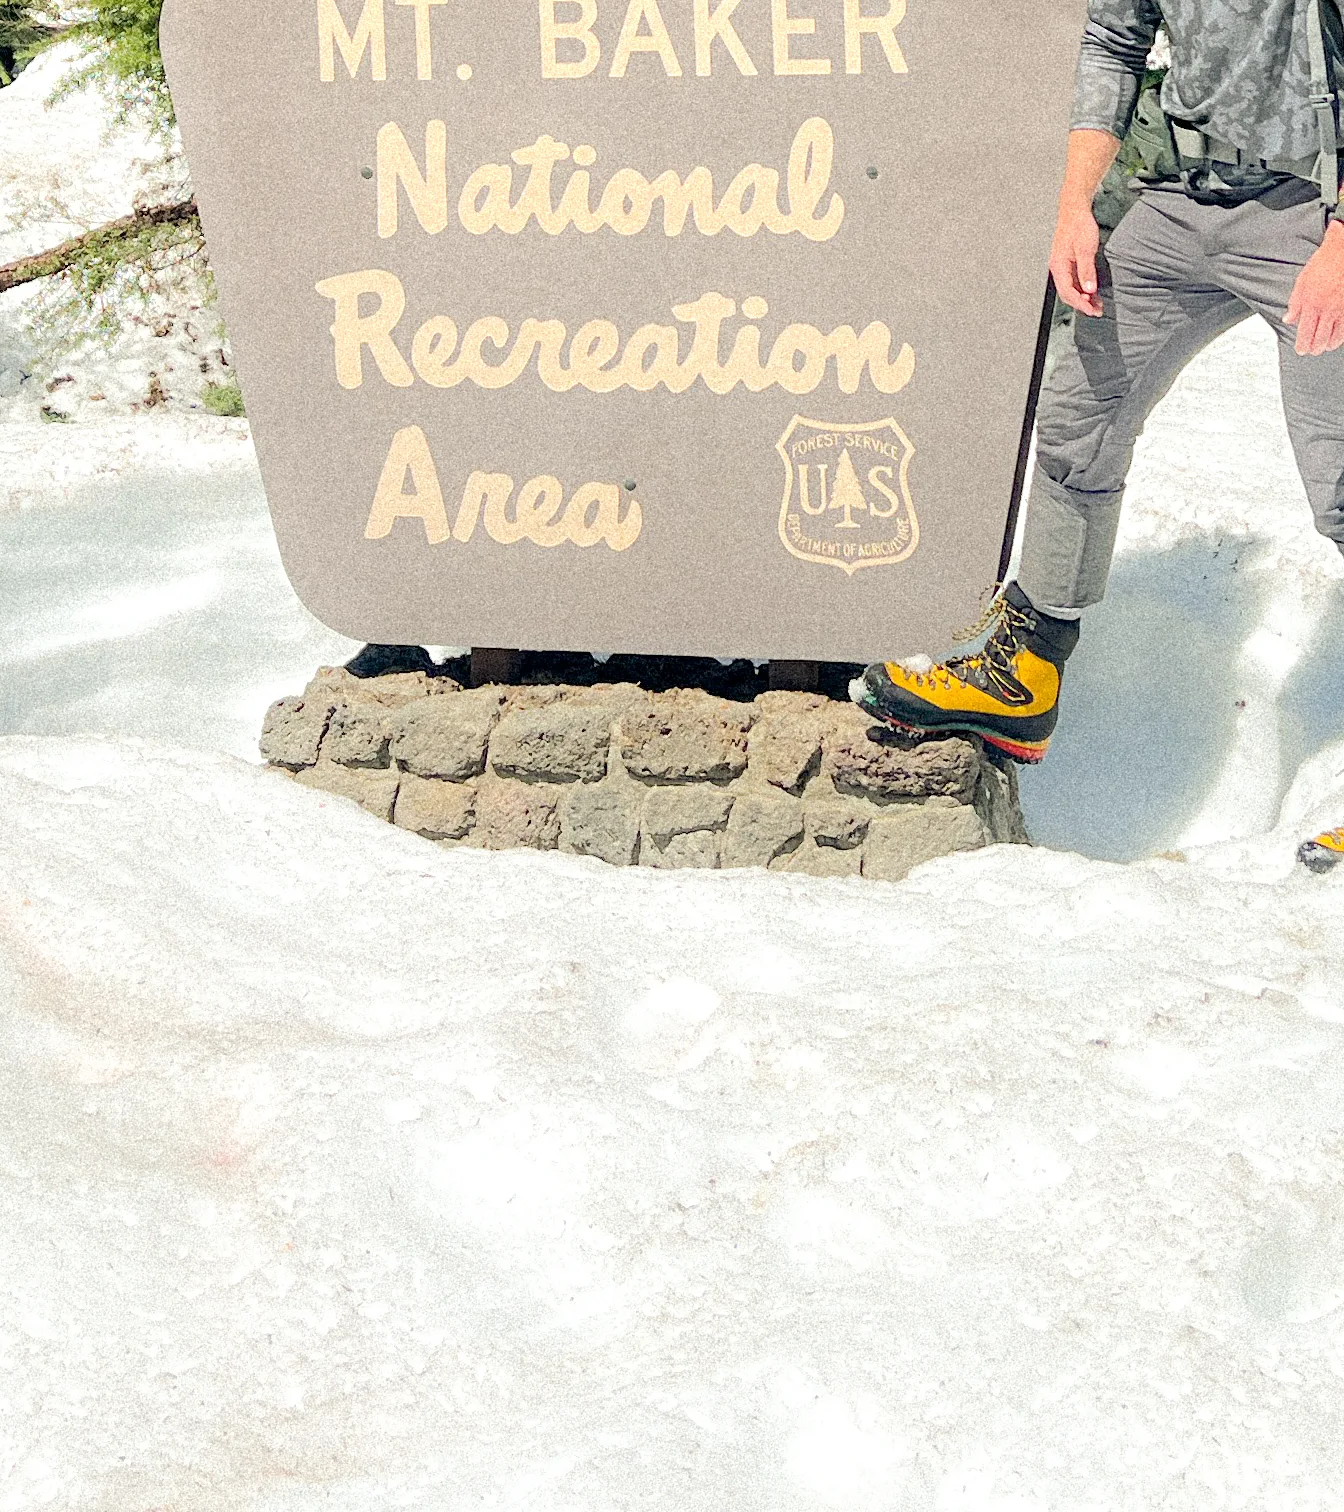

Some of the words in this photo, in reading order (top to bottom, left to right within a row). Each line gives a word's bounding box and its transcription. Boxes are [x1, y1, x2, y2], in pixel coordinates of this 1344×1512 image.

[376, 117, 845, 242] National
[316, 269, 916, 395] Recreation
[364, 425, 644, 552] Area
[792, 433, 840, 459] FOREST
[844, 432, 899, 461] SERVICE
[787, 513, 841, 556] DEPARTMENT
[843, 542, 856, 557] OF
[857, 517, 910, 557] AGRICULTURE
